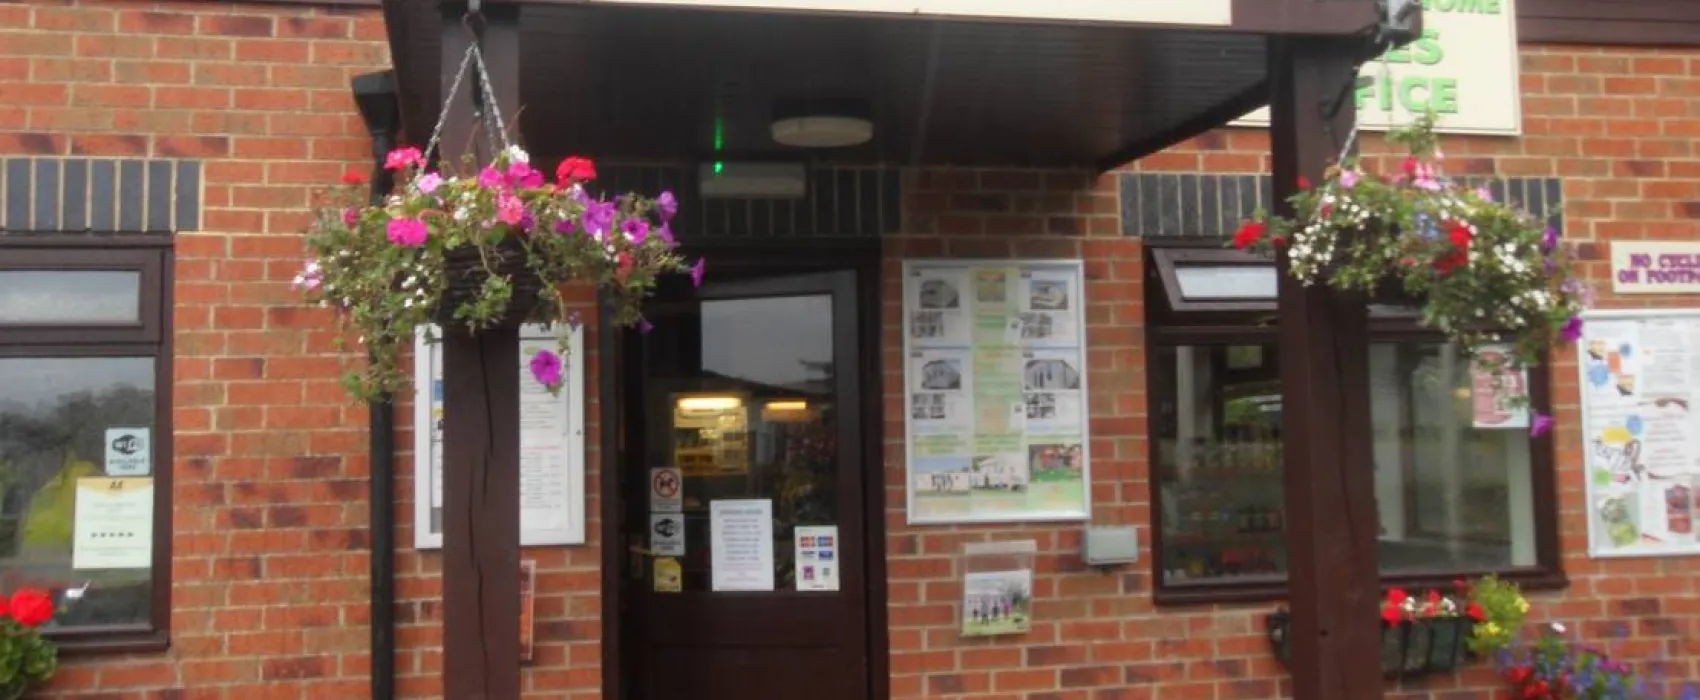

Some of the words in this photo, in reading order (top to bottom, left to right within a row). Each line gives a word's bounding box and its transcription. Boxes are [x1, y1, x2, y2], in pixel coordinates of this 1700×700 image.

[1422, 0, 1501, 14] OME
[1630, 252, 1652, 269] NO
[1617, 270, 1639, 284] ON
